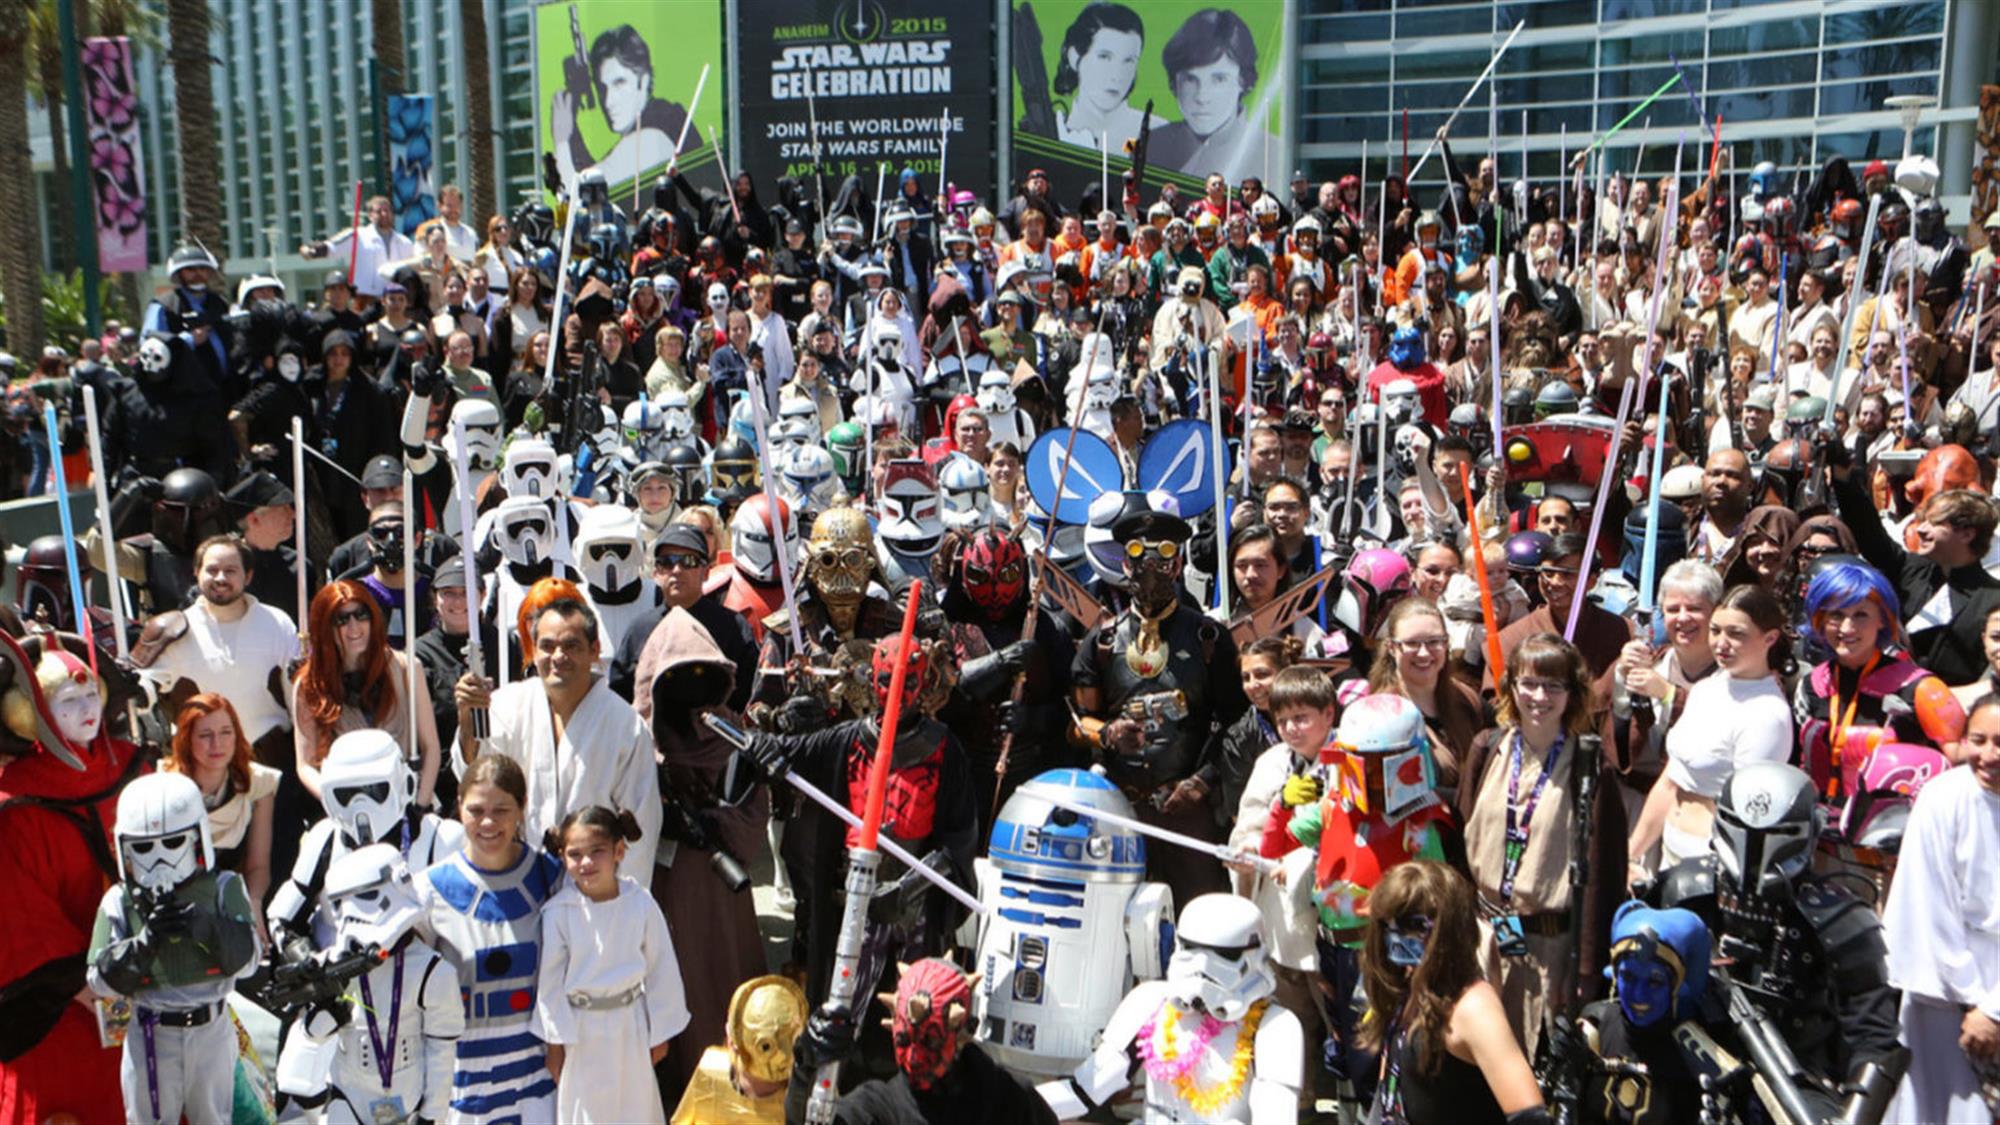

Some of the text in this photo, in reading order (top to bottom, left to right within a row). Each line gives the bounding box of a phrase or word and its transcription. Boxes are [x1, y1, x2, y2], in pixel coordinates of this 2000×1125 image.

[773, 24, 829, 40] ANAHEIM
[891, 17, 947, 33] 2015
[771, 40, 952, 70] STAR WARS
[771, 66, 951, 99] CELEBRATION
[766, 117, 964, 138] JOIN THE WORLDWIDE
[780, 138, 948, 158] STAR WARS FAMILY
[785, 162, 834, 178] APRL
[840, 161, 857, 176] 16
